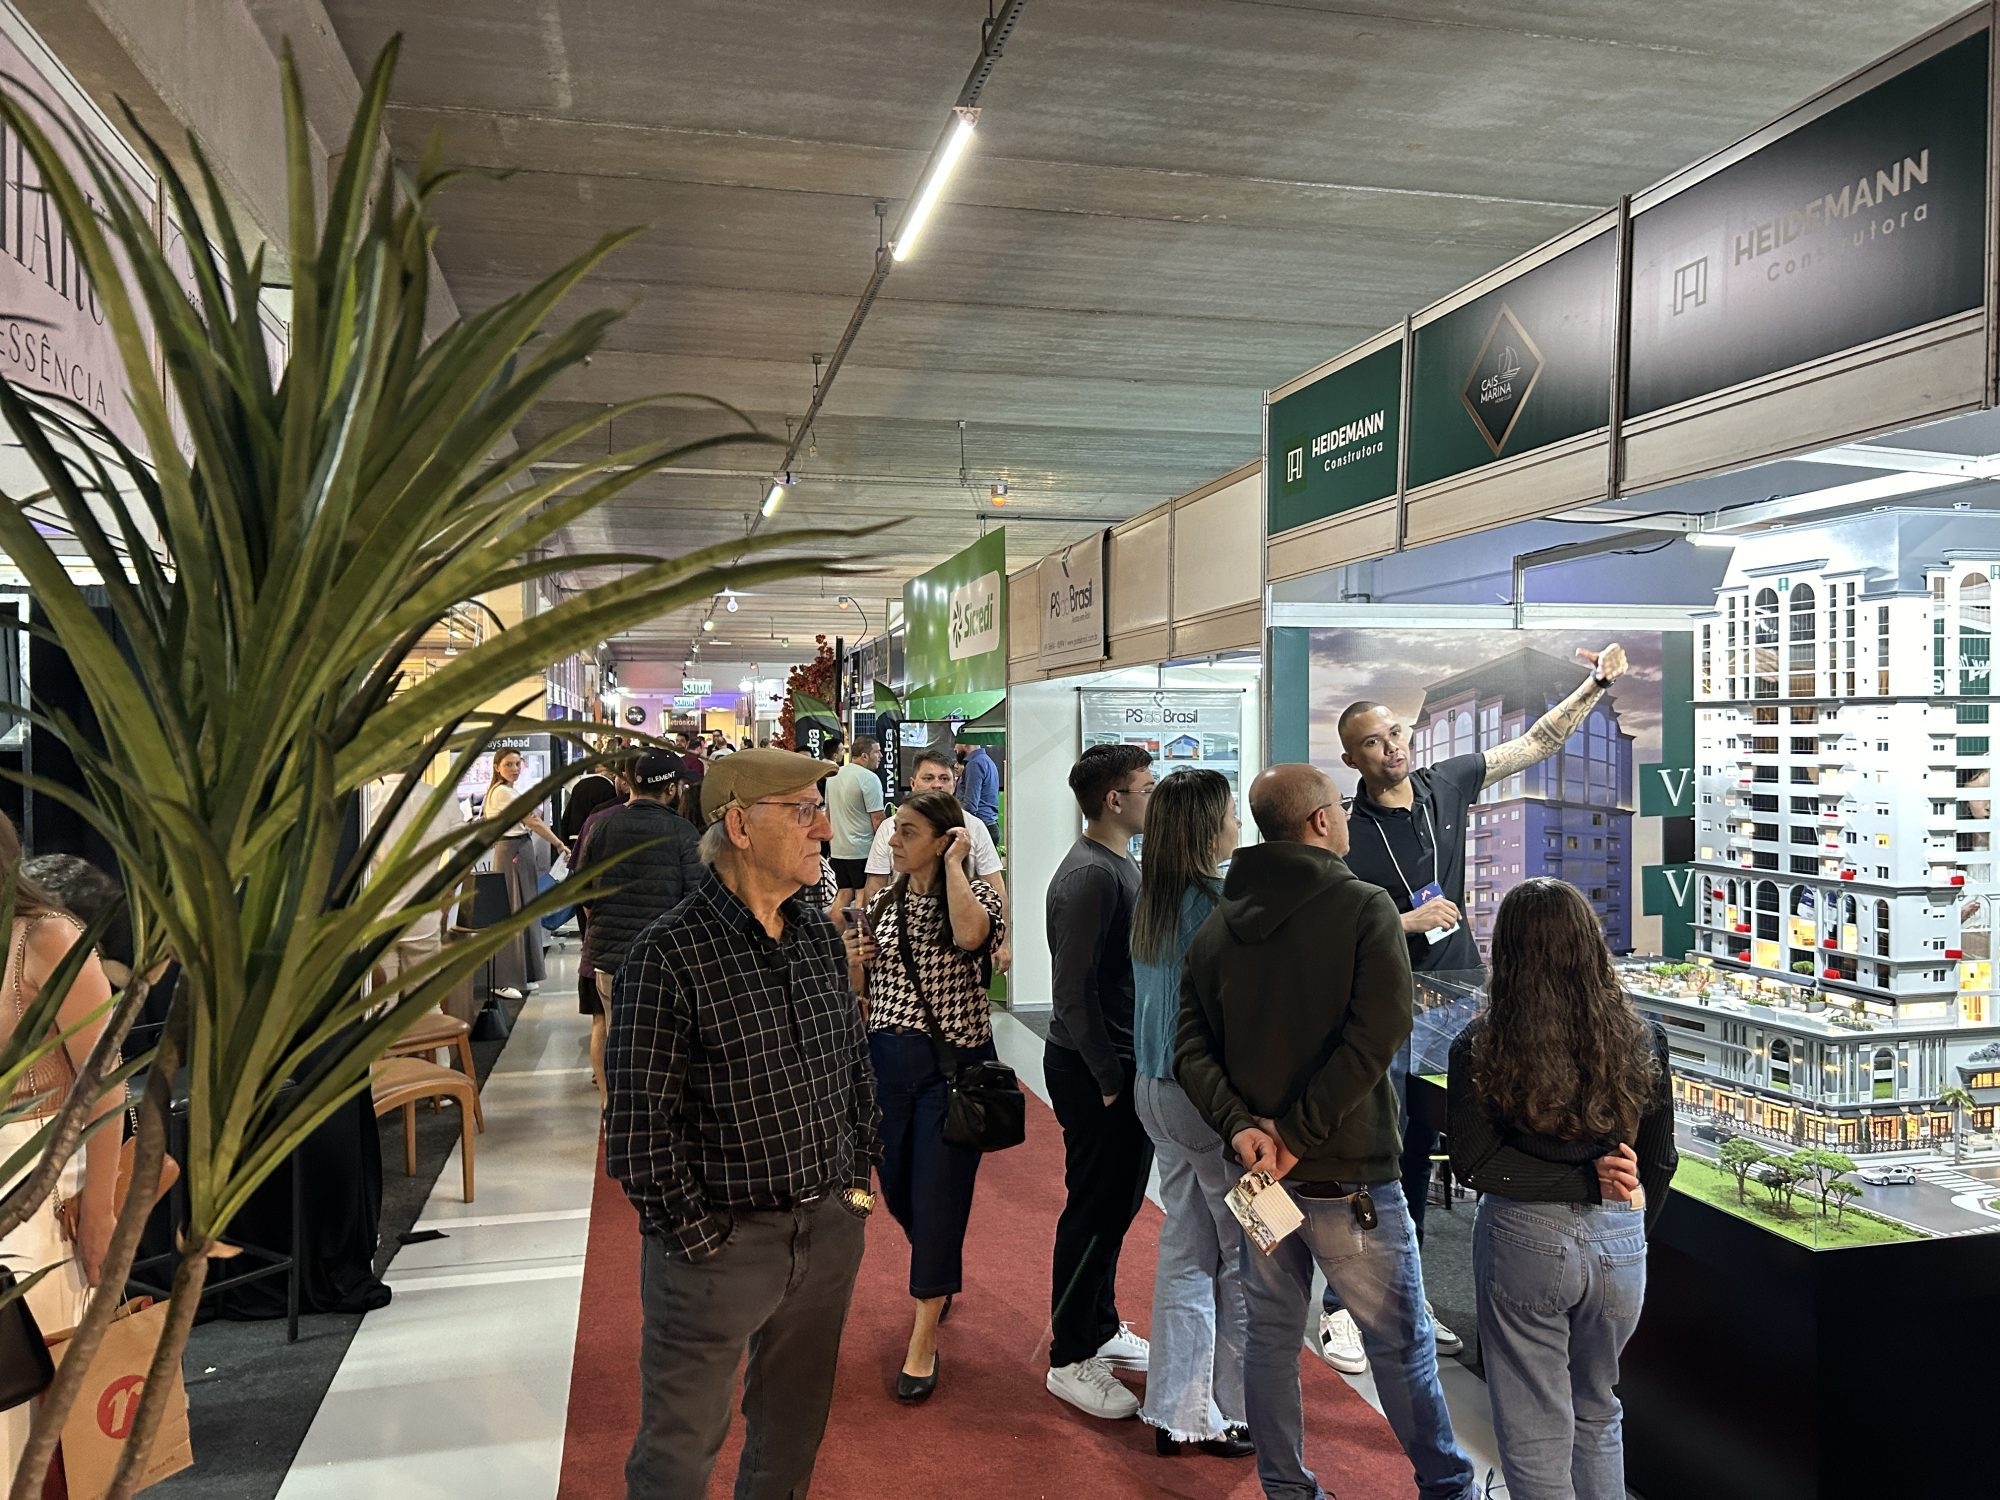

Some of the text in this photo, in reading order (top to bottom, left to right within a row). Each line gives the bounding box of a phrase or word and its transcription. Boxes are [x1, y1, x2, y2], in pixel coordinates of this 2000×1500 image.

[1733, 148, 1930, 266] HEIDEMANN
[1480, 382, 1512, 404] MARINA
[1481, 374, 1499, 392] CAIS
[1311, 409, 1385, 459] HEIDEMANN
[1323, 441, 1384, 473] Construtora
[1069, 577, 1093, 613] Brasil
[963, 592, 994, 639] Sicredi
[1125, 708, 1144, 724] PS
[1163, 708, 1199, 724] Brasil
[501, 736, 530, 748] ahead
[647, 770, 676, 784] ELEMENT
[884, 728, 895, 798] Invicta
